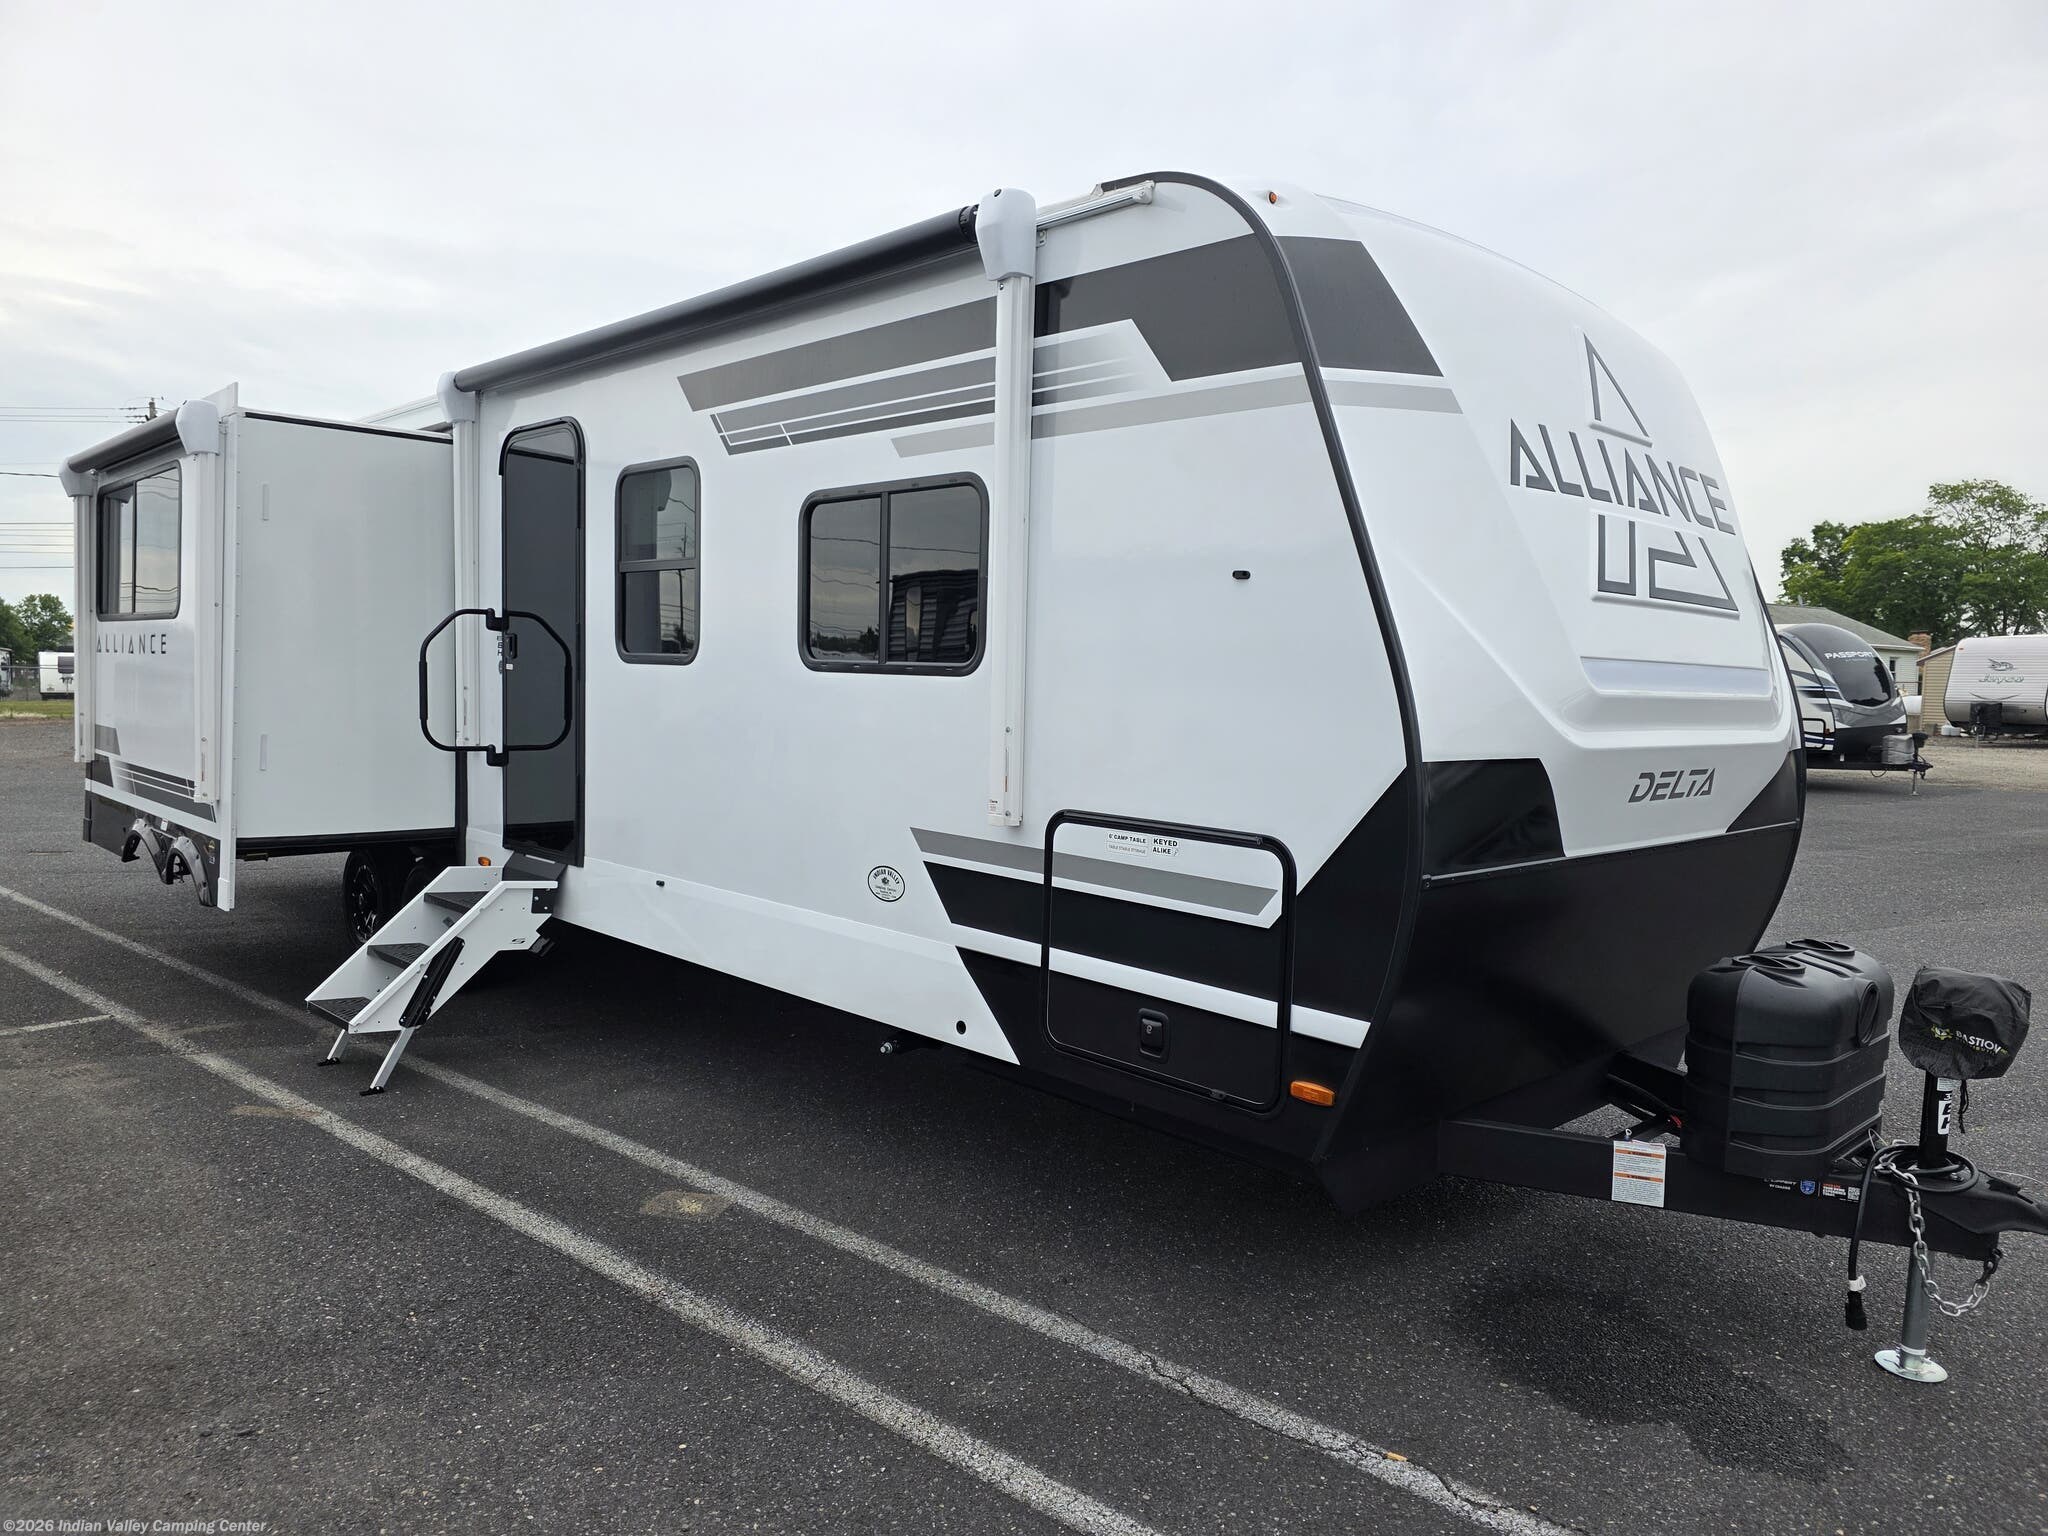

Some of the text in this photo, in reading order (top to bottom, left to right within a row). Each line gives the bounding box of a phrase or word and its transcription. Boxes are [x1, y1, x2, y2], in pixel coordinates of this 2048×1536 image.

[1509, 417, 1736, 535] ALLIANCE
[96, 633, 167, 655] ALLIANCE
[1824, 651, 1875, 660] PASSPORT
[1628, 767, 1716, 803] DELTA
[1153, 838, 1178, 847] KEYED
[1152, 846, 1172, 855] ALIKE
